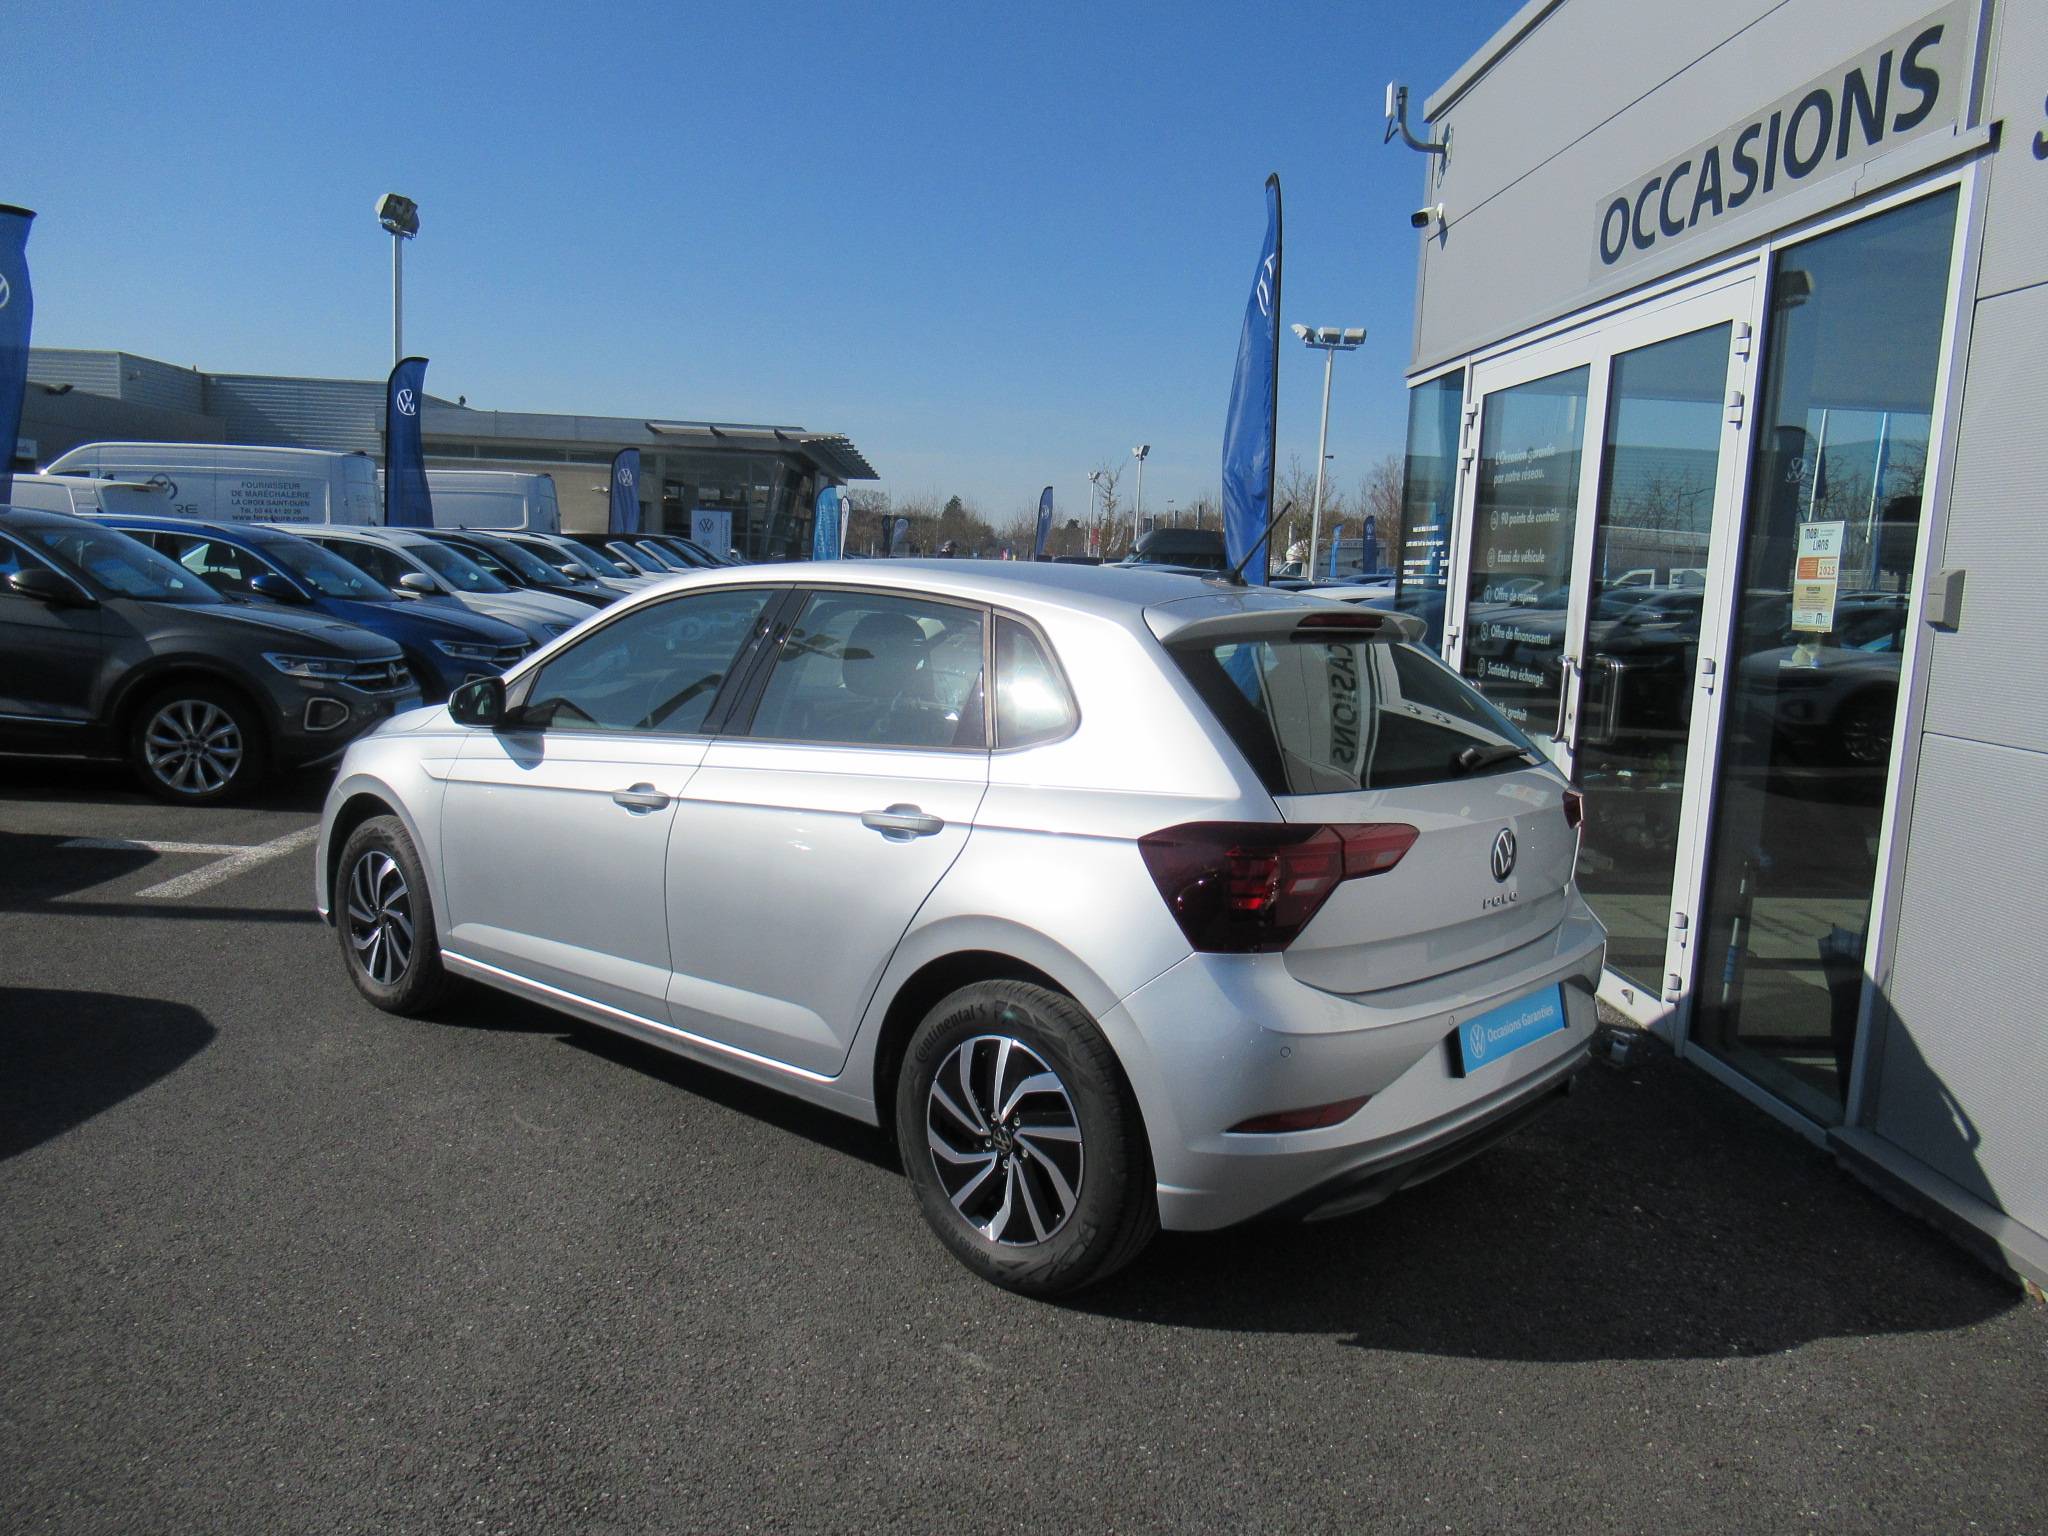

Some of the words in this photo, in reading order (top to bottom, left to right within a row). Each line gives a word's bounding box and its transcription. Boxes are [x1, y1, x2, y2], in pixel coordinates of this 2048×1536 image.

[1600, 24, 1944, 265] OCCASIONS
[1501, 511, 1509, 525] 90
[1509, 511, 1526, 527] points
[1527, 509, 1535, 523] de
[1536, 507, 1559, 522] contrôle
[1512, 549, 1520, 562] du
[1521, 548, 1544, 563] véhicule
[1819, 566, 1835, 575] 2025
[1494, 587, 1509, 600] Offre
[1510, 588, 1517, 601] de
[1491, 624, 1505, 639] Offre
[1506, 626, 1513, 640] de
[1514, 626, 1550, 645] financement
[1488, 661, 1509, 678] Satisfait
[1510, 670, 1518, 679] ou
[1519, 667, 1544, 687] échangé
[1482, 891, 1518, 909] POLO
[917, 1004, 976, 1061] Continental
[1487, 1018, 1521, 1042] Occasions
[1522, 1005, 1553, 1026] Garanties
